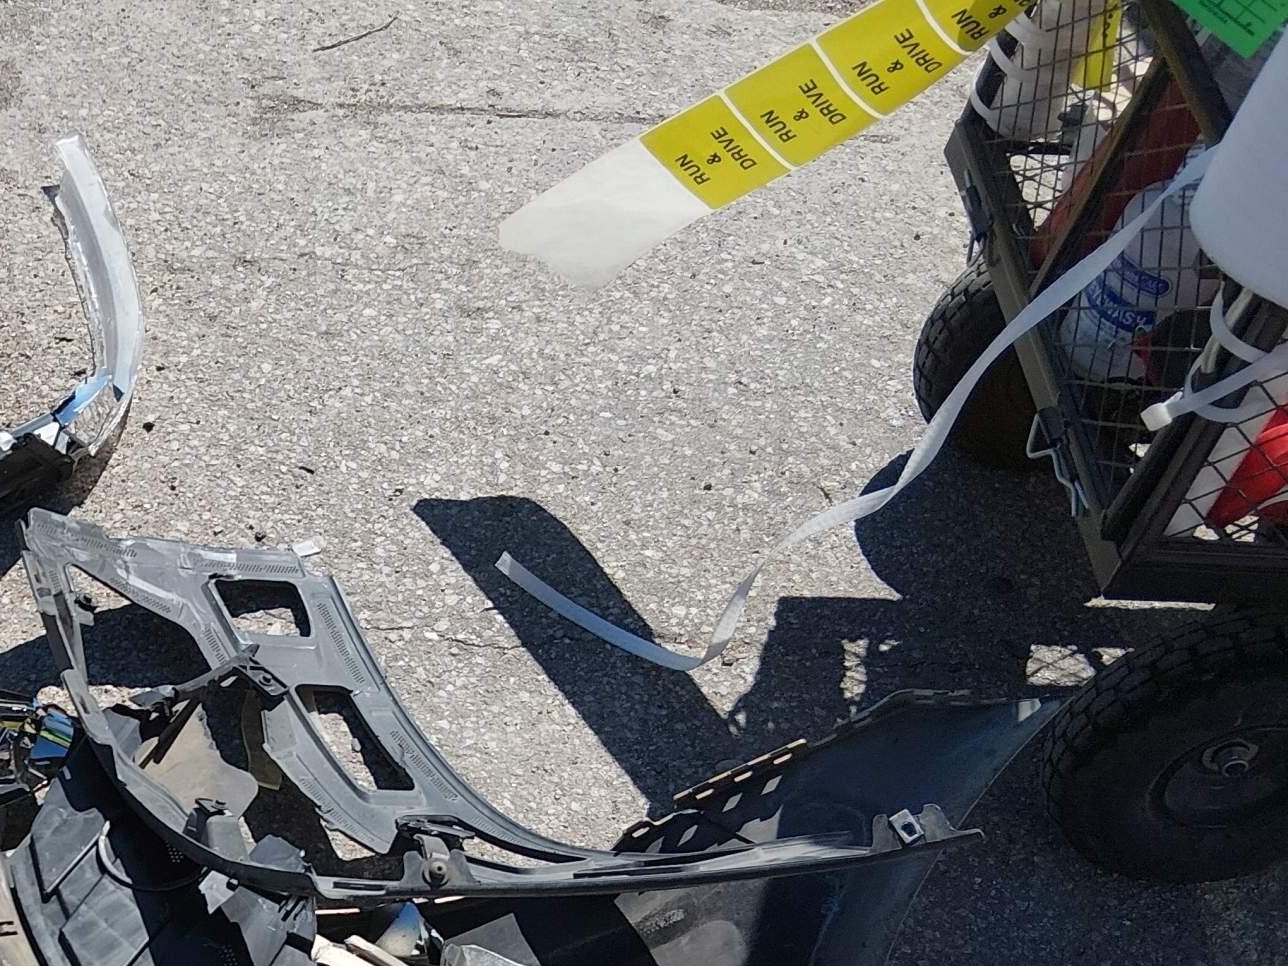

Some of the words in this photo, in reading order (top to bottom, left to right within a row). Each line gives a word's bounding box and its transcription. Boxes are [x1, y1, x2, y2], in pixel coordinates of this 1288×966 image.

[951, 8, 990, 40] RUN
[988, 5, 1007, 19] &
[886, 58, 904, 73] &
[893, 27, 943, 74] DRIVE
[852, 60, 890, 96] RUN
[793, 107, 810, 121] &
[798, 78, 847, 125] DRIVE
[760, 109, 797, 143] RUN
[706, 152, 722, 165] &
[710, 126, 758, 170] DRIVE
[675, 153, 711, 185] RUN
